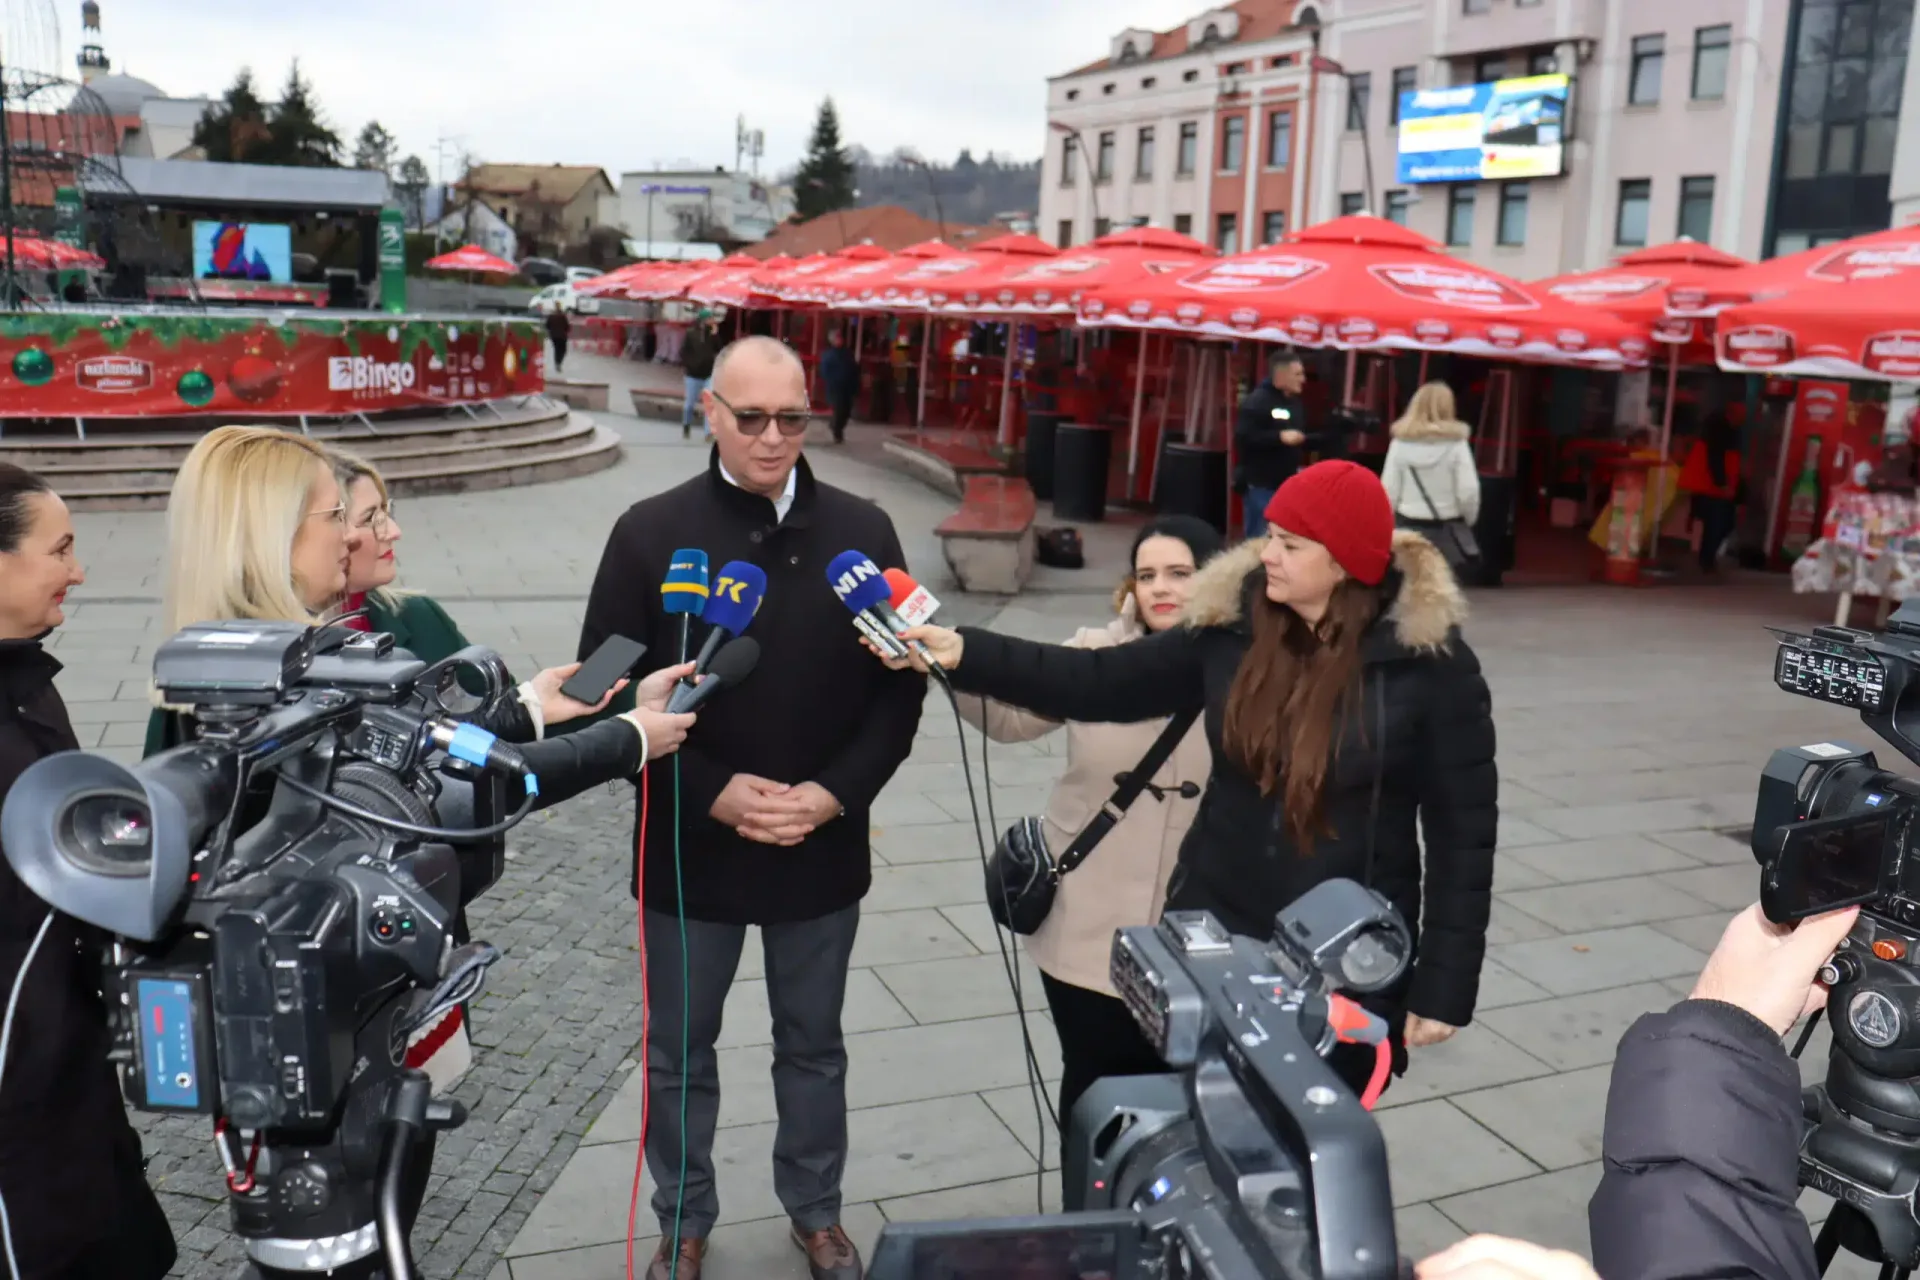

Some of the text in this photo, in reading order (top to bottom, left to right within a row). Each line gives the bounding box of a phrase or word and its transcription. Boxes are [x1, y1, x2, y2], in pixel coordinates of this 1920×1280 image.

[353, 355, 416, 395] Bingo
[715, 577, 748, 604] TK
[833, 571, 859, 602] N1
